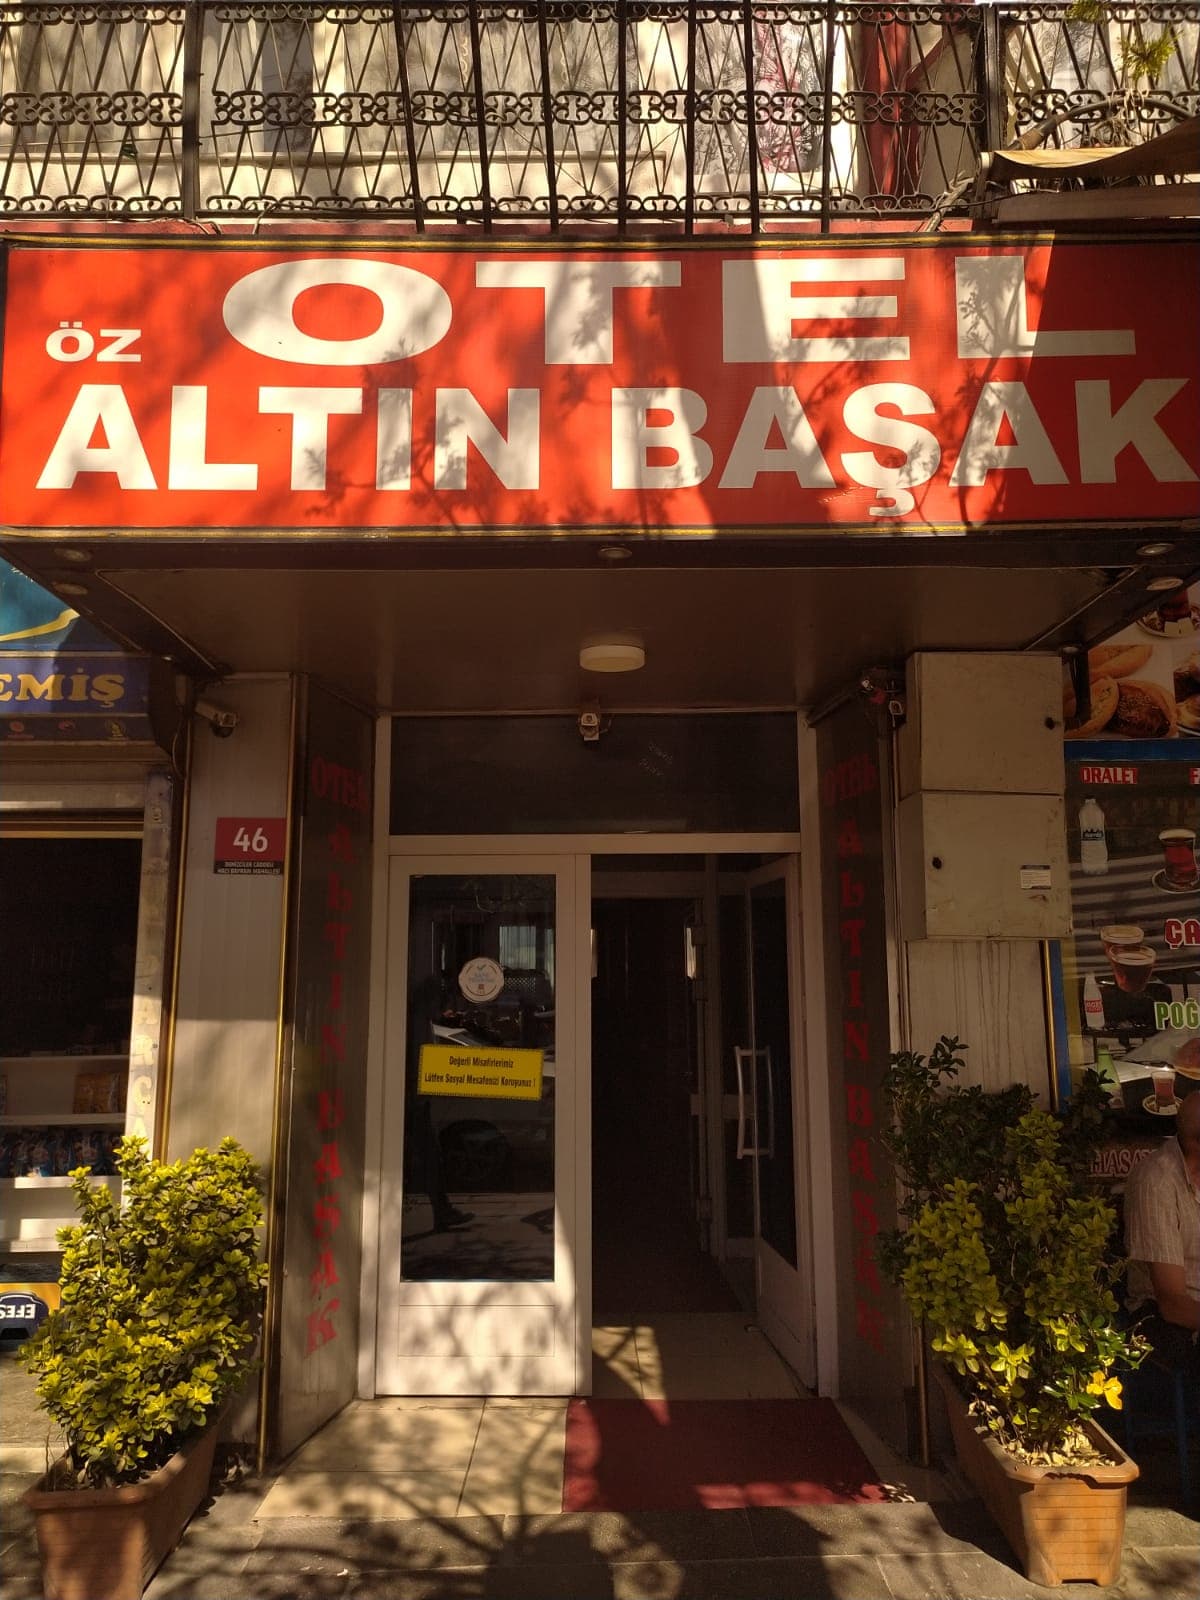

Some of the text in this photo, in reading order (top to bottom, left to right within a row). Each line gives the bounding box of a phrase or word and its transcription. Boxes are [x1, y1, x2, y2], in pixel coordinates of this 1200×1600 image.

[222, 255, 1136, 366] OTEL
[45, 320, 142, 362] ÖZ
[35, 378, 1200, 517] ALTIN BAŞAK
[233, 827, 268, 853] 46
[449, 1055, 471, 1067] Değerli
[425, 1072, 444, 1083] Lütfen
[445, 1073, 465, 1085] Sosyal
